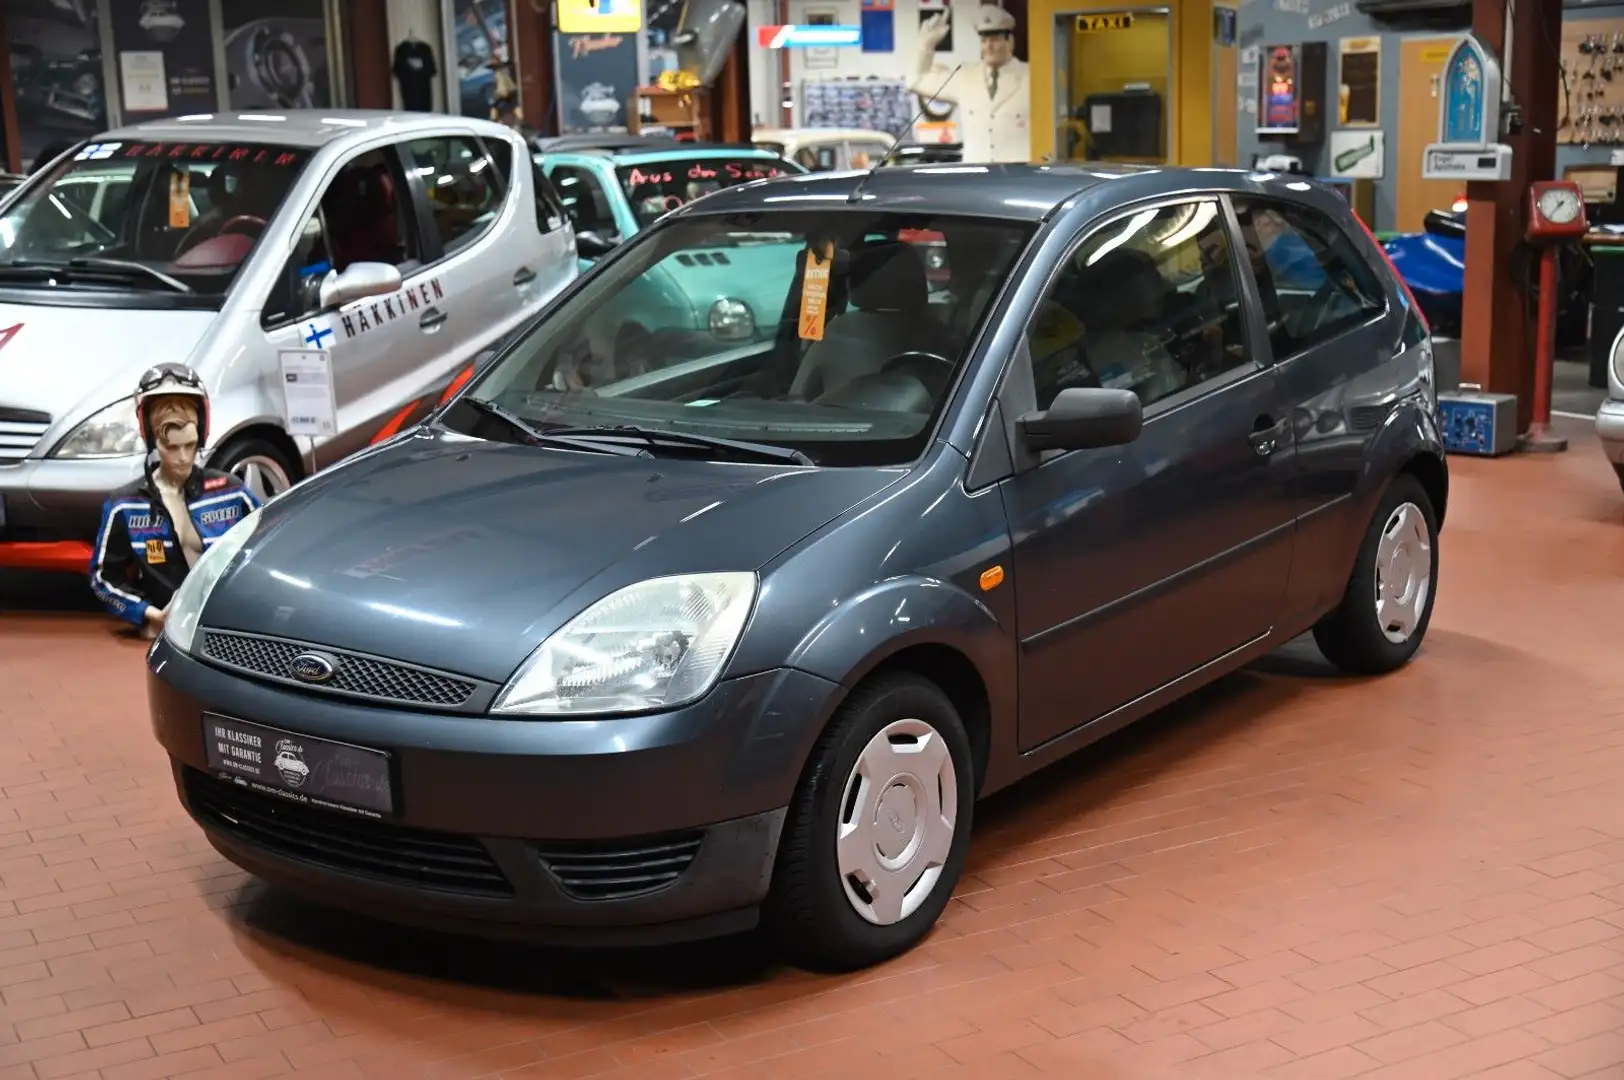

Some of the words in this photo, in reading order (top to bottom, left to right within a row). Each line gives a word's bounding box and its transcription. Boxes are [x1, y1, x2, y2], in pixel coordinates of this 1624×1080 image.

[1084, 15, 1124, 29] TAXI
[341, 277, 444, 339] HÄKKINEN
[297, 659, 320, 675] Ford
[214, 726, 227, 739] IHR
[227, 729, 262, 748] KLASSIKER
[217, 742, 230, 755] MIT
[231, 745, 263, 764] GARANTIE
